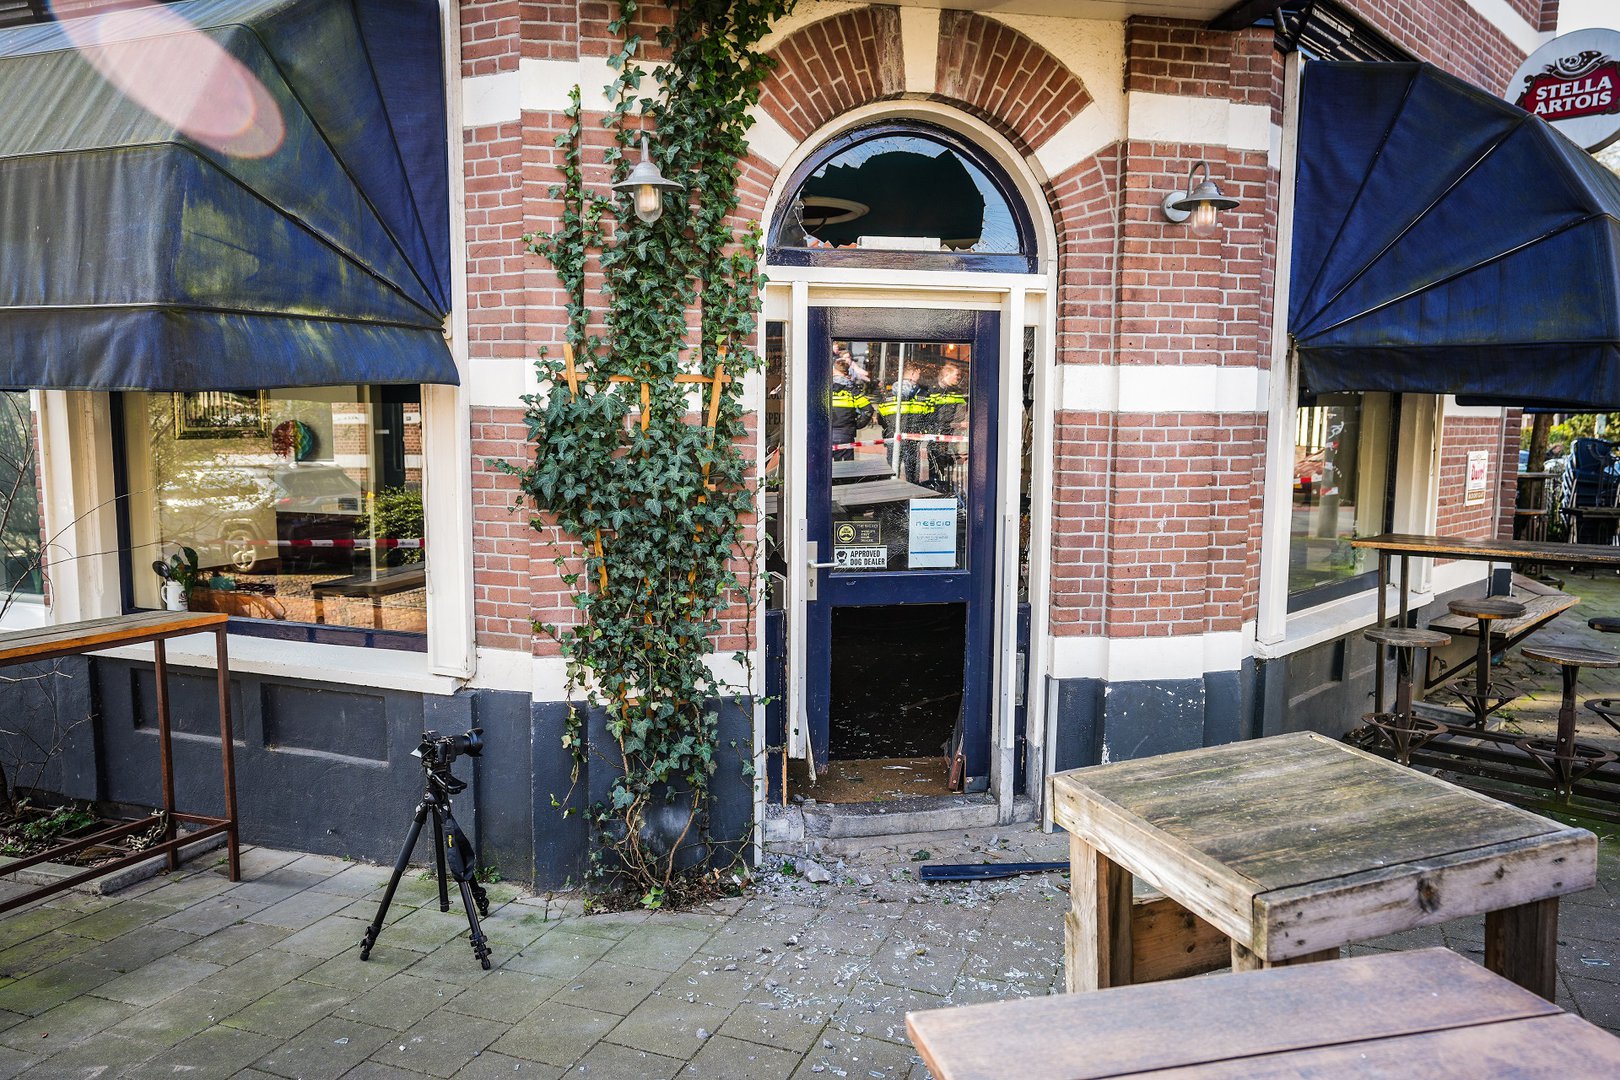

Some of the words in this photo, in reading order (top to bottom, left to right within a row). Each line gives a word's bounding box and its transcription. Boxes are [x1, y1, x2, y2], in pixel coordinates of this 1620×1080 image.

[1536, 76, 1612, 101] STELLA
[1534, 91, 1612, 115] ARTOIS
[850, 549, 881, 558] APPROVED
[850, 558, 862, 566] DOG
[863, 557, 886, 566] DEALER
